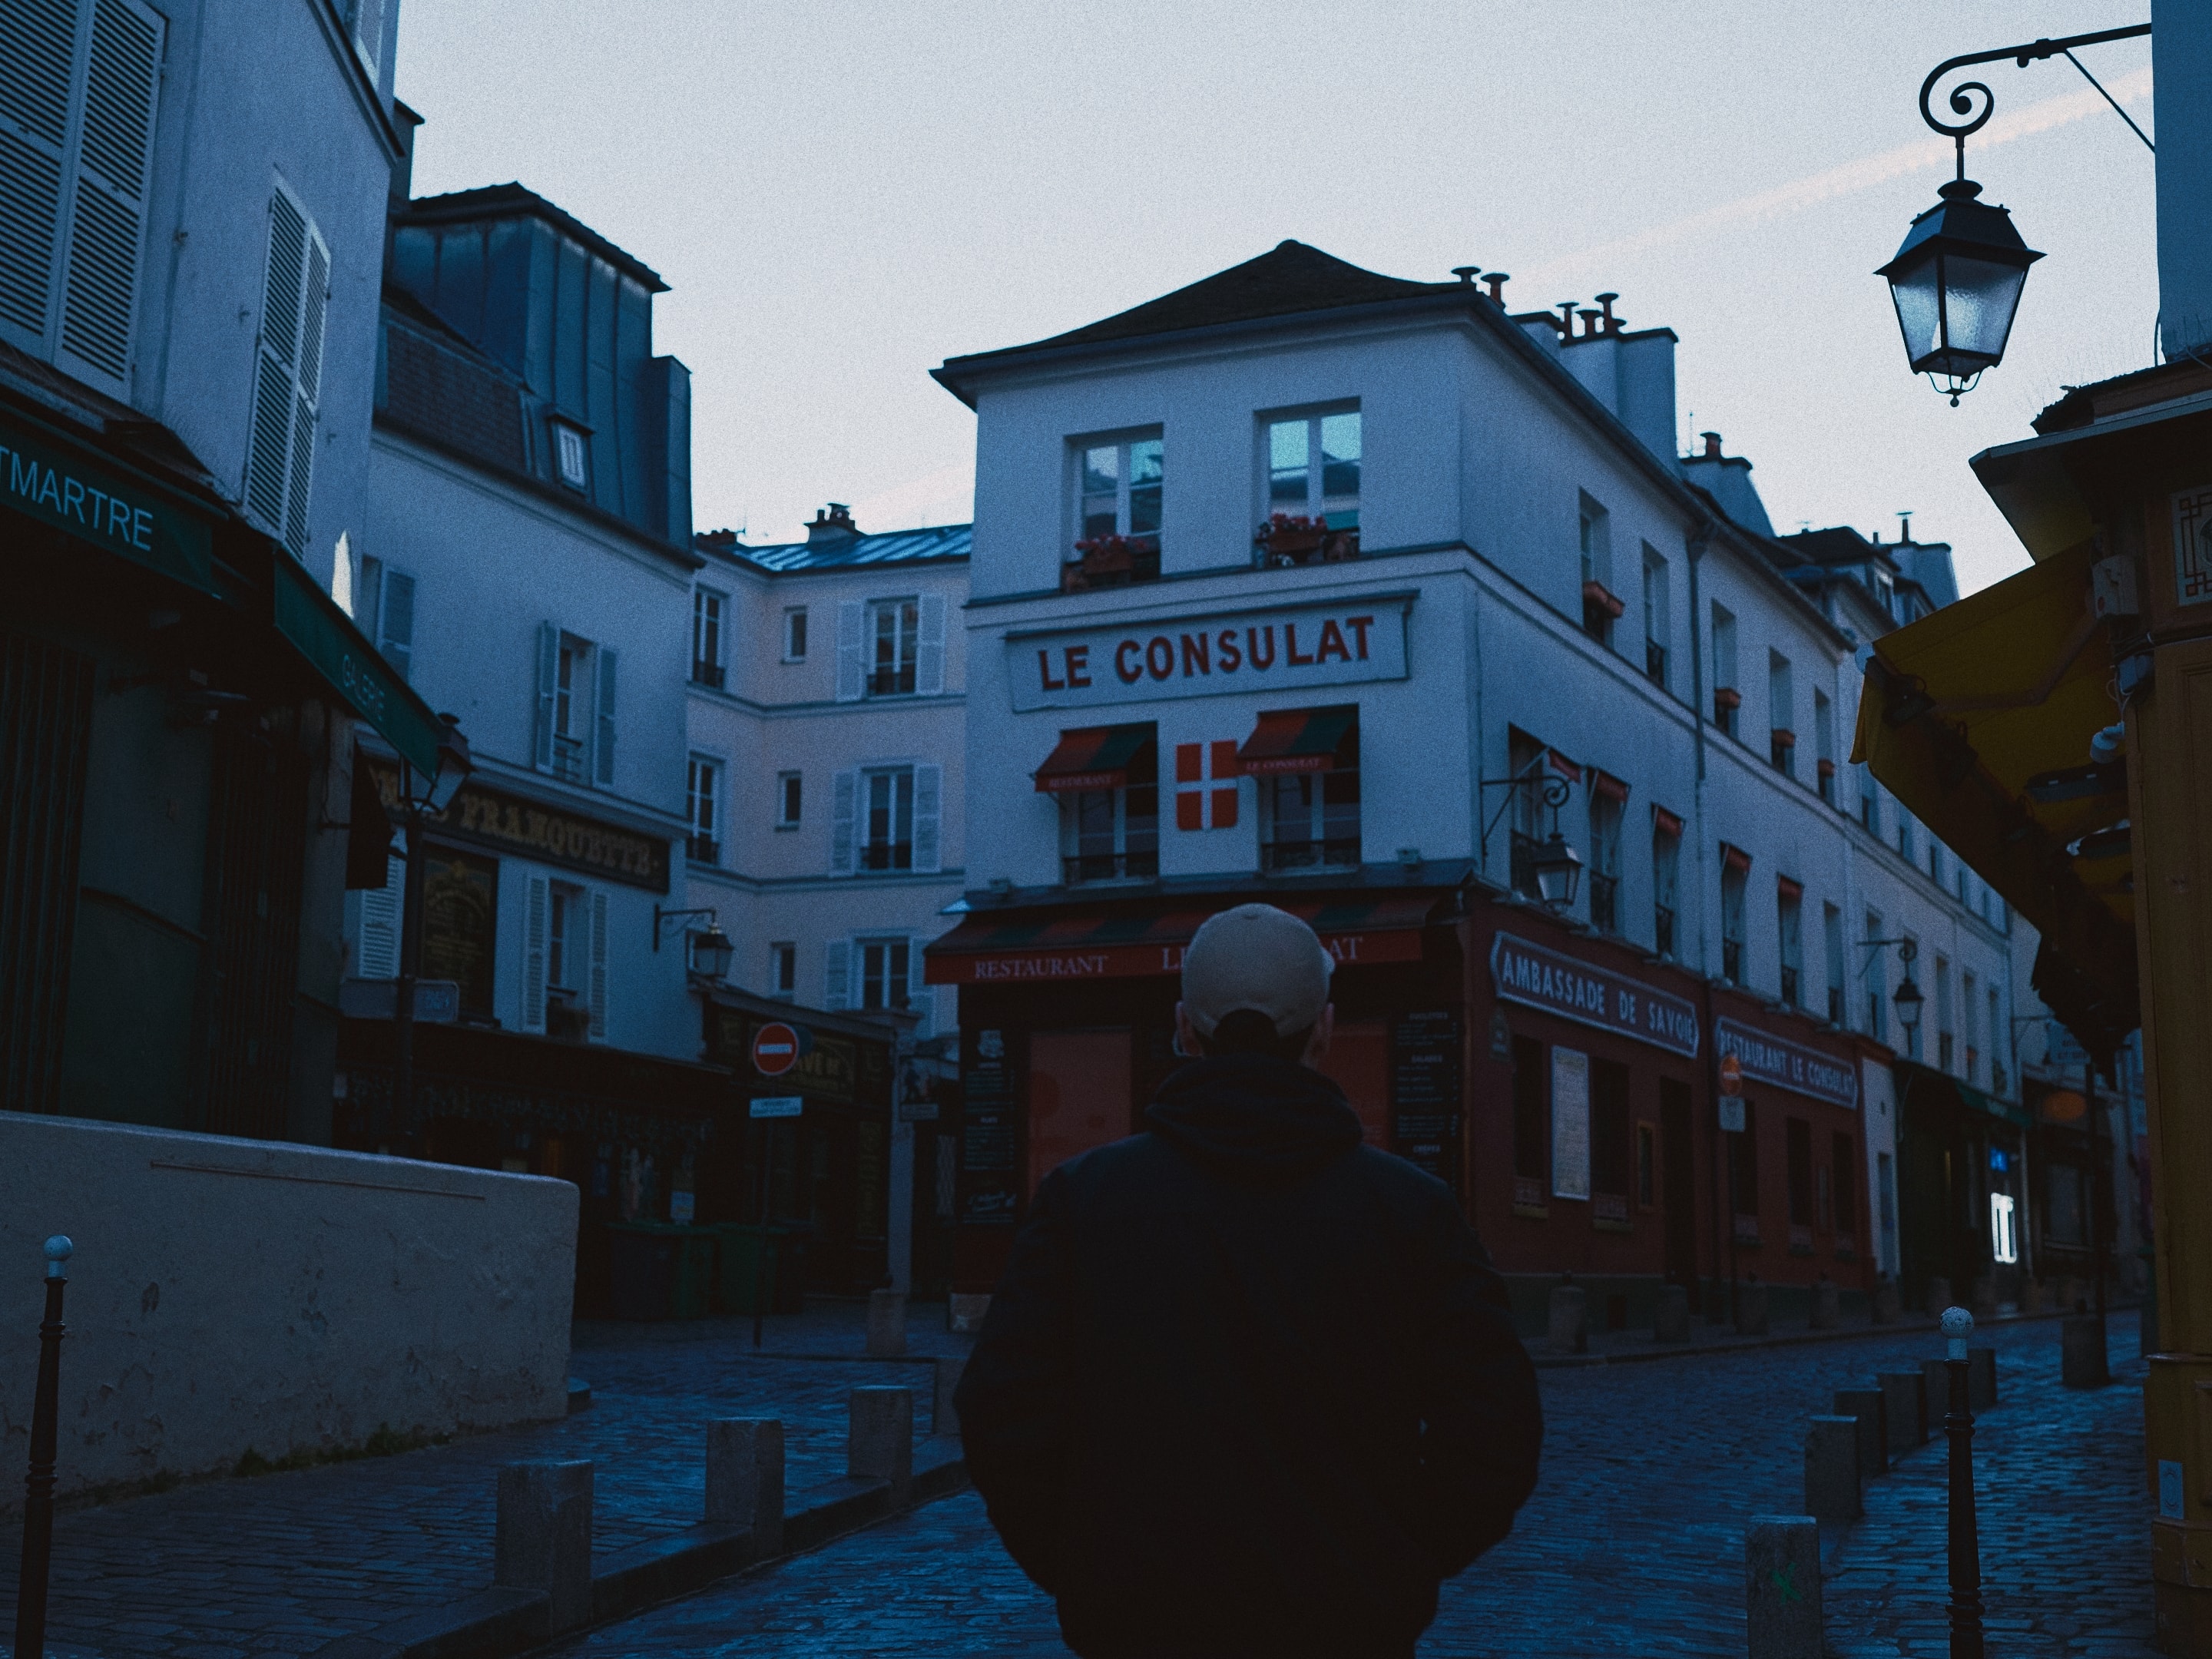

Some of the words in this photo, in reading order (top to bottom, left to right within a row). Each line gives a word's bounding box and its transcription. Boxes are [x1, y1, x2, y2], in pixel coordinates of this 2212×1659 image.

[1038, 646, 1091, 690] LE
[1115, 616, 1374, 683] CONSULAT
[975, 955, 1110, 979] RESTAURANT
[1502, 951, 1605, 1016] AMBASSADE
[1618, 988, 1636, 1025] DE
[1648, 1001, 1694, 1045] SAVOIE
[1791, 1055, 1804, 1082] LE
